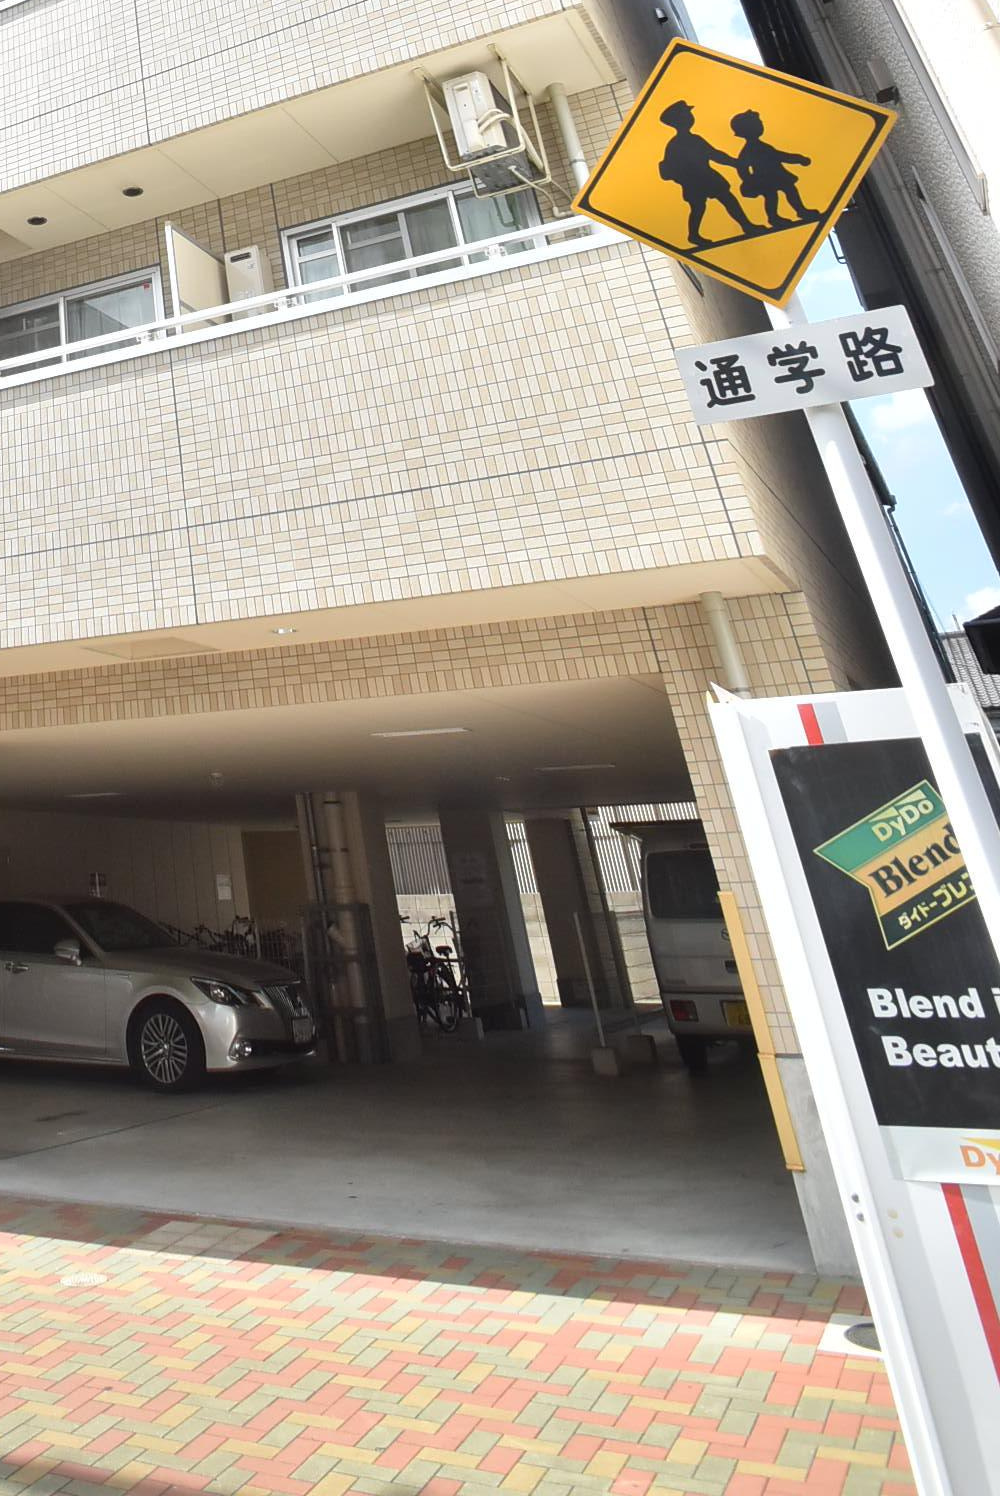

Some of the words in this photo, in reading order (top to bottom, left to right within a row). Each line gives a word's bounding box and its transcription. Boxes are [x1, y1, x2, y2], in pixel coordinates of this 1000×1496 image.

[694, 326, 905, 409] 通学路
[871, 798, 934, 842] DyDo
[897, 872, 975, 931] ダイドーブレ
[866, 987, 986, 1019] Blend
